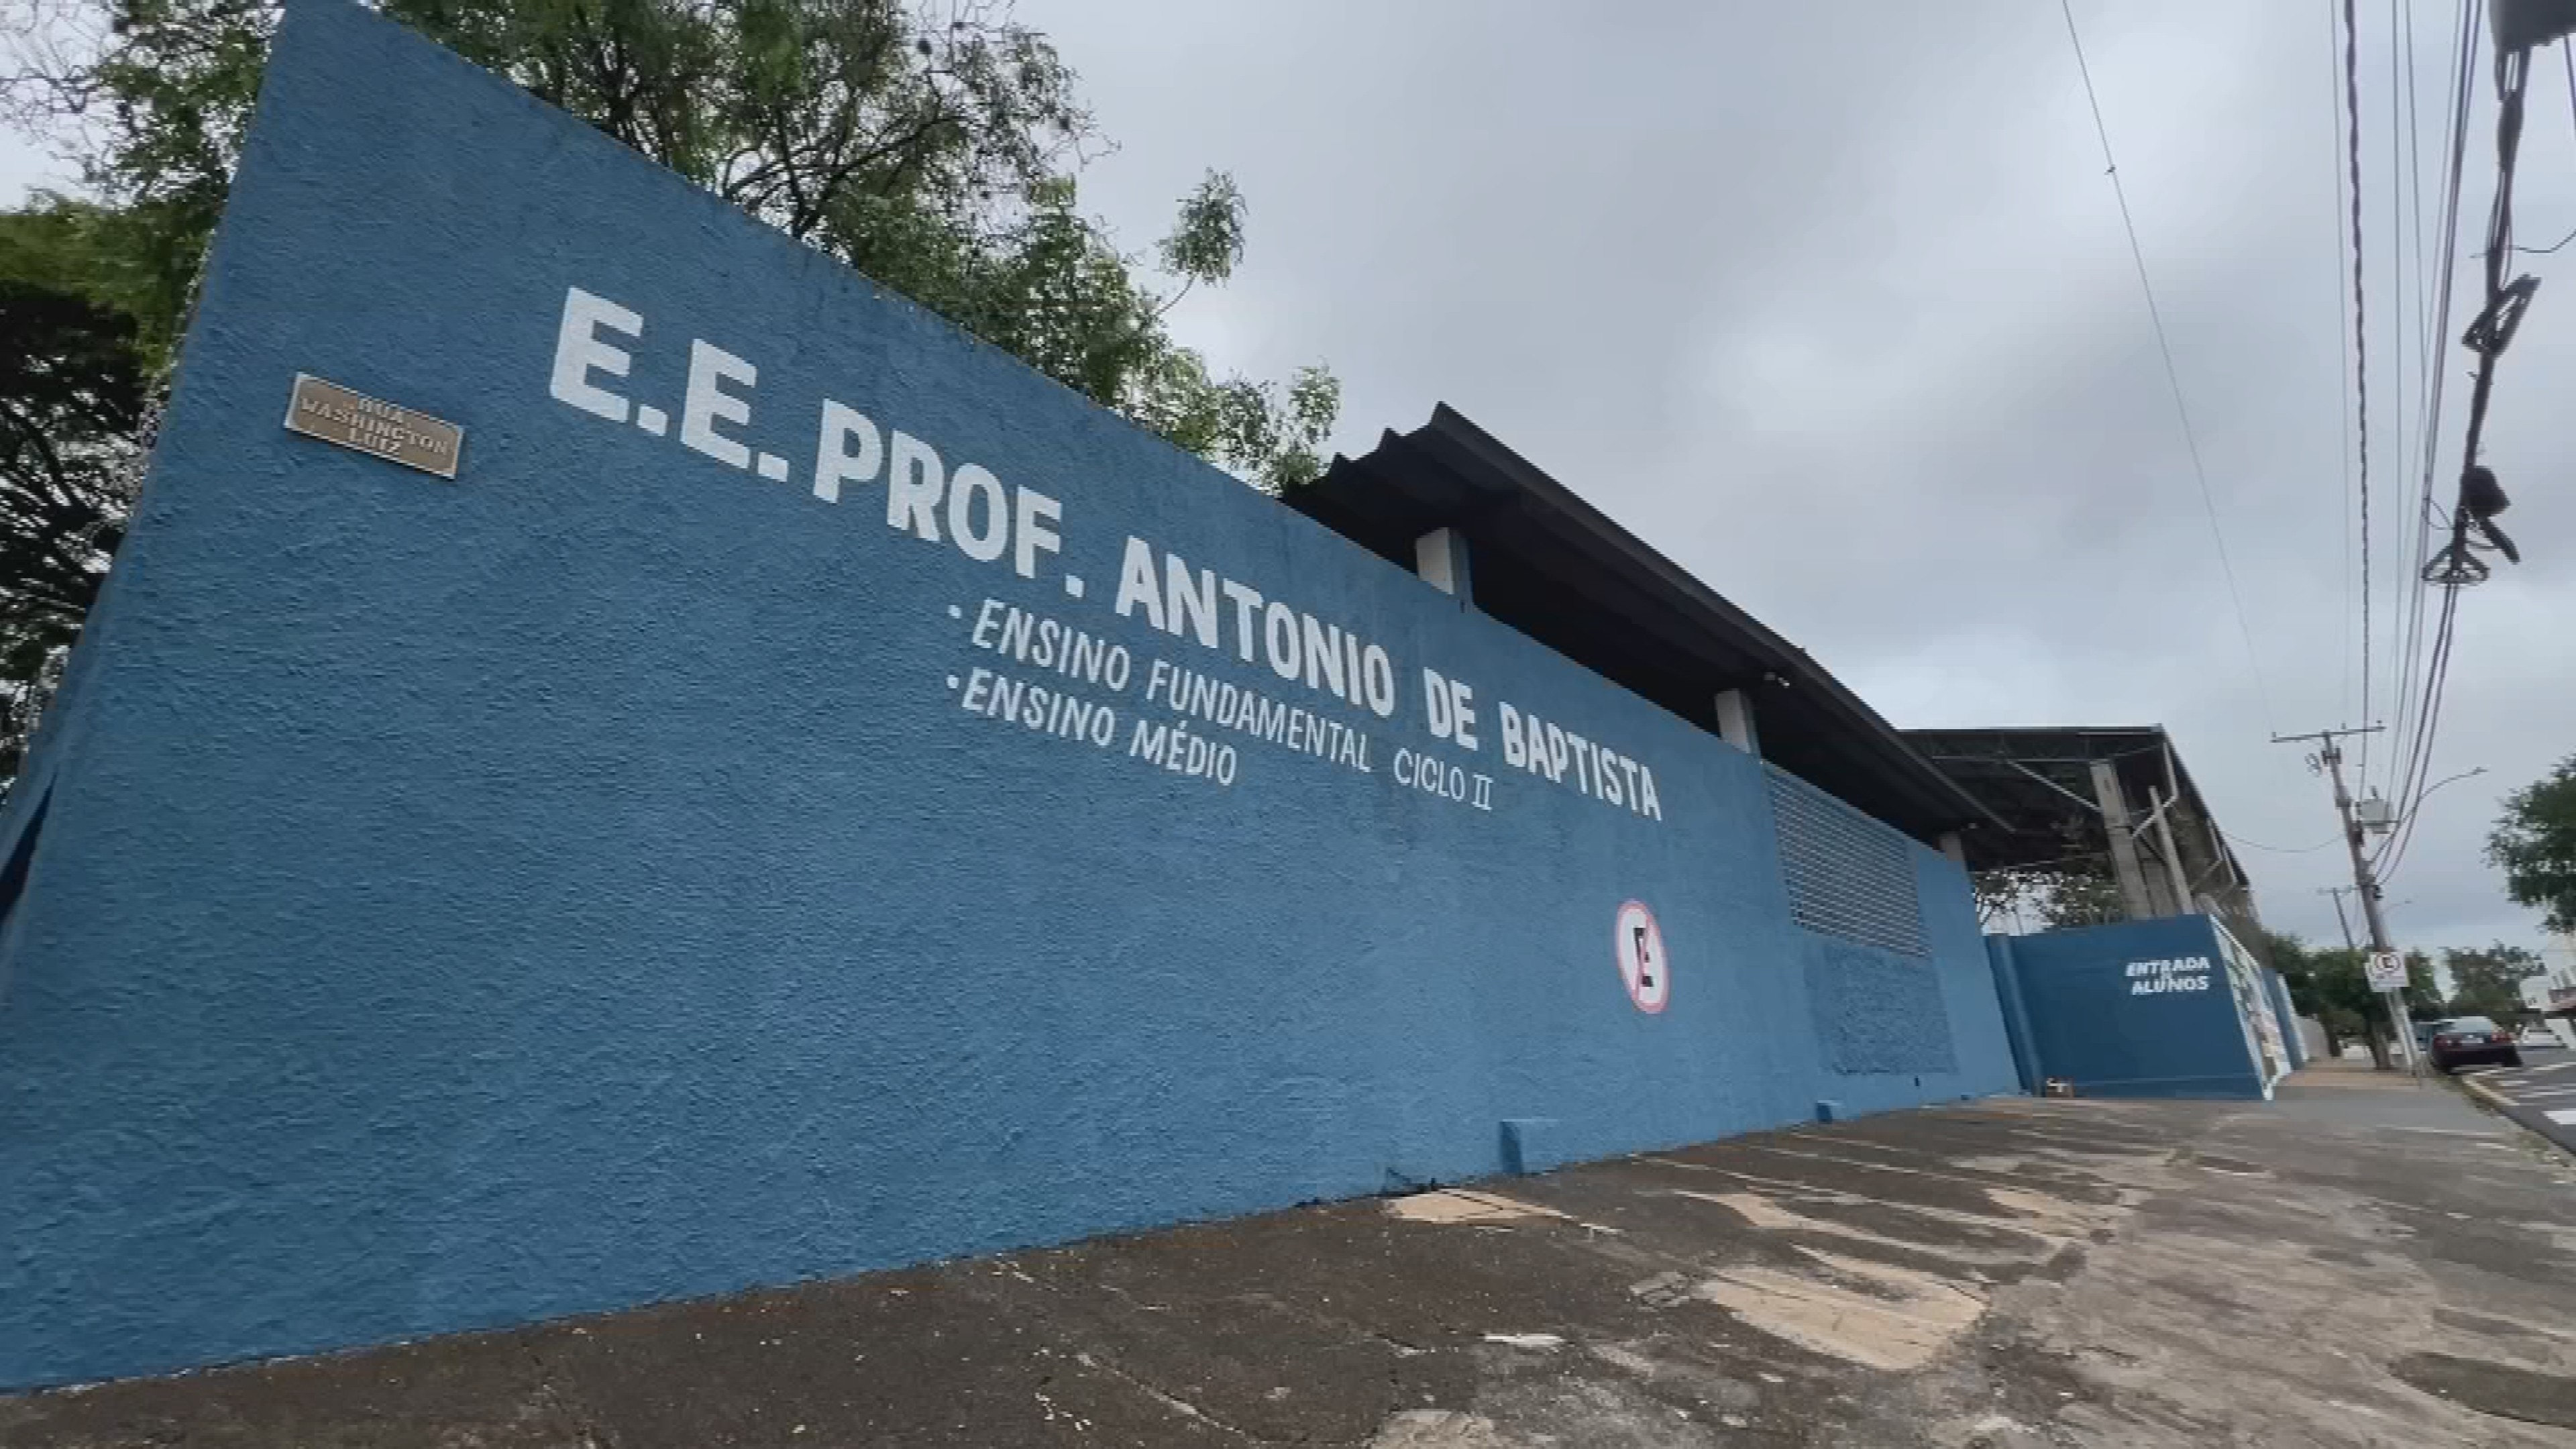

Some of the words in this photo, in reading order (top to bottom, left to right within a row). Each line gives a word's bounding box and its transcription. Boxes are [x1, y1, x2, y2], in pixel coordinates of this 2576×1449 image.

[301, 397, 448, 455] WASHINGTON
[813, 398, 1083, 598] PROF.
[1116, 535, 1395, 716] ANTONIO
[1423, 667, 1479, 751] DE
[1499, 700, 1662, 821] BAPTISTA
[961, 666, 1115, 747] ENSINO
[1129, 719, 1237, 786] MÉDIO
[972, 598, 1130, 692] ENSINO
[1146, 658, 1371, 773] FUNDAMENTAL
[1394, 747, 1466, 802] CICLO
[1471, 774, 1493, 812] II
[2125, 957, 2210, 977] ENTRADA
[2131, 975, 2210, 996] ALUNOS
